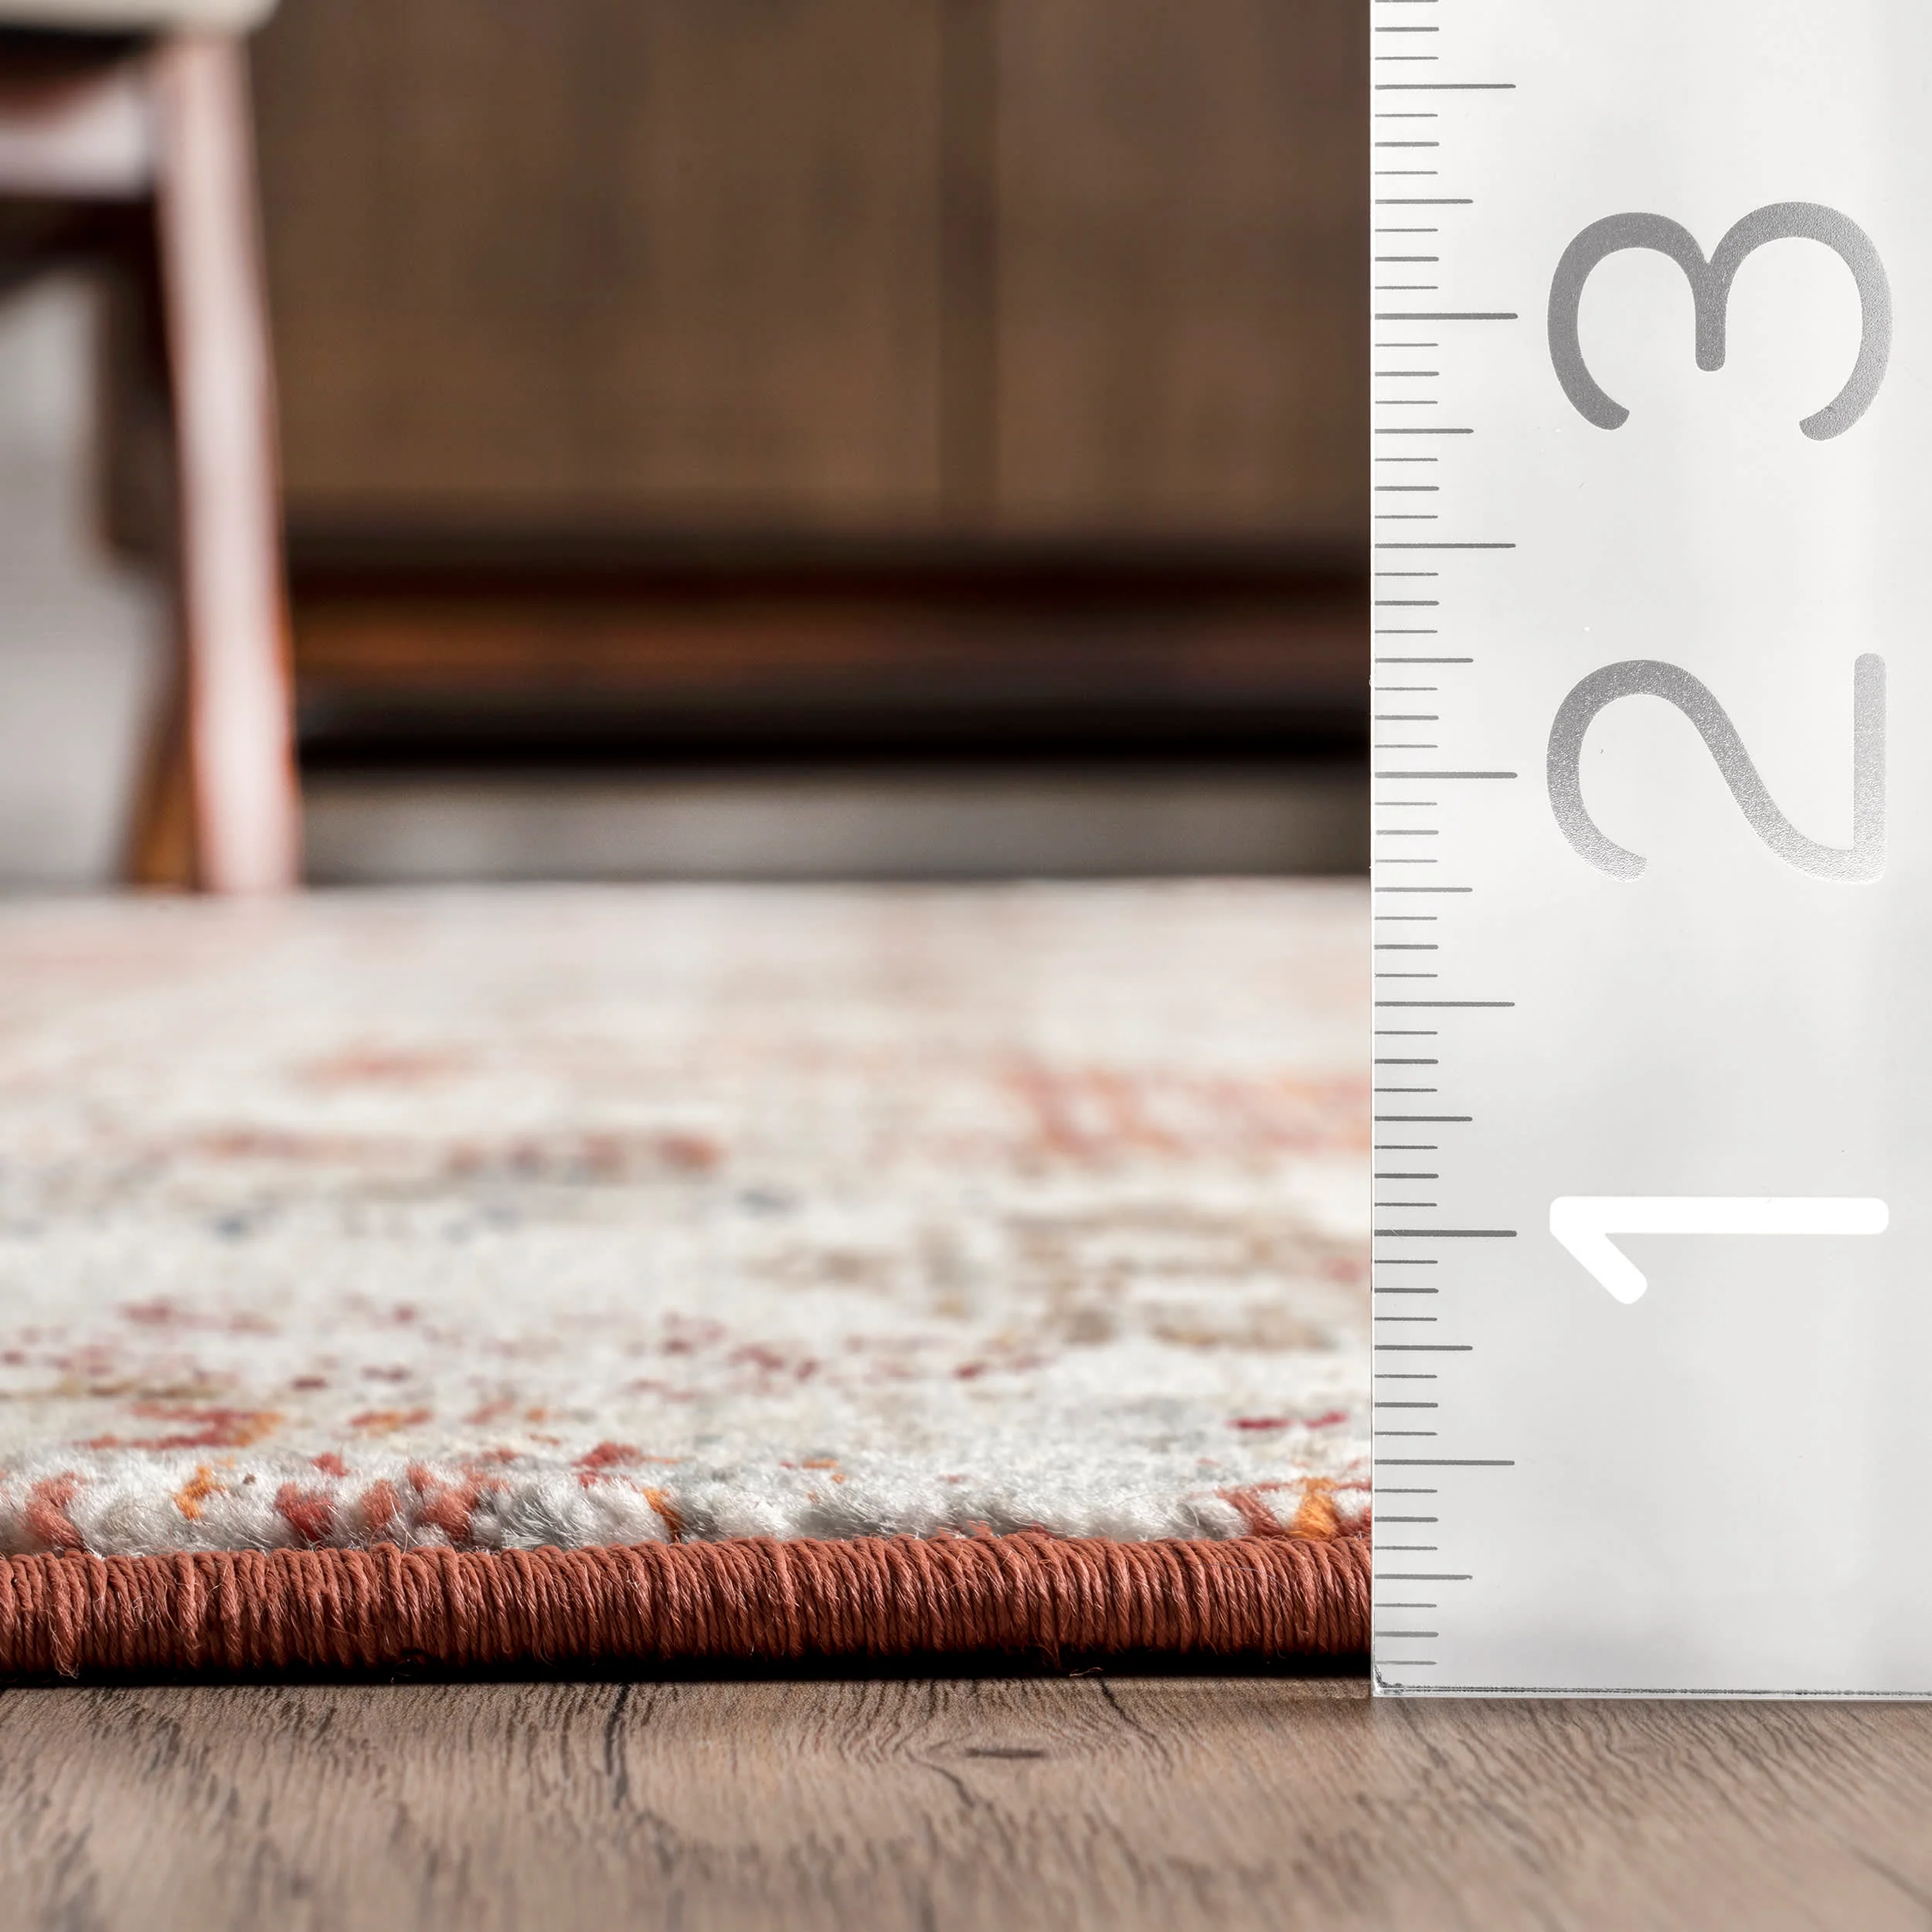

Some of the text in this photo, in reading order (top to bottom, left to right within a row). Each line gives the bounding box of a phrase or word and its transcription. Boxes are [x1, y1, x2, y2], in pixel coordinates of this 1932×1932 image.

[1547, 202, 1893, 441] 3
[1547, 653, 1886, 884] 2
[1549, 1196, 1889, 1304] 1
